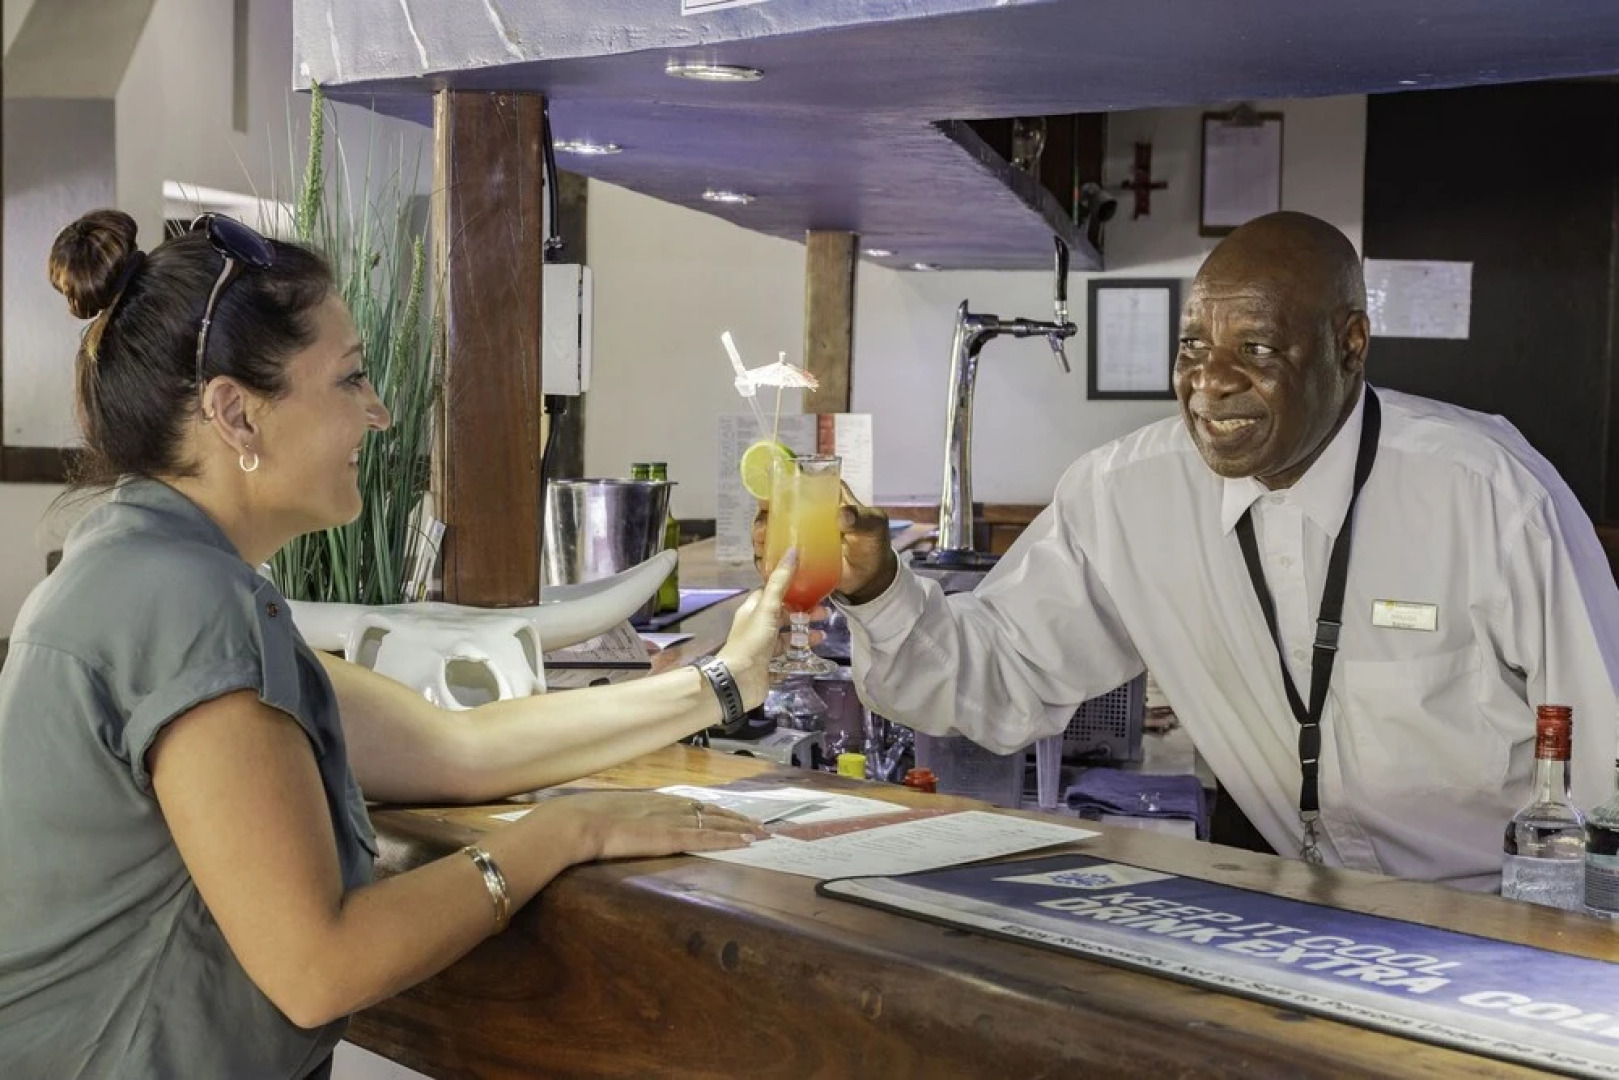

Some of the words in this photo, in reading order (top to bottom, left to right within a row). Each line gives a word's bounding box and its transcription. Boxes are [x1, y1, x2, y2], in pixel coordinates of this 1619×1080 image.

[1034, 897, 1244, 943] DRINK
[1217, 939, 1451, 994] EXTRA
[1089, 891, 1243, 923] KEEP
[1227, 922, 1311, 937] IT
[1294, 935, 1462, 976] COOL
